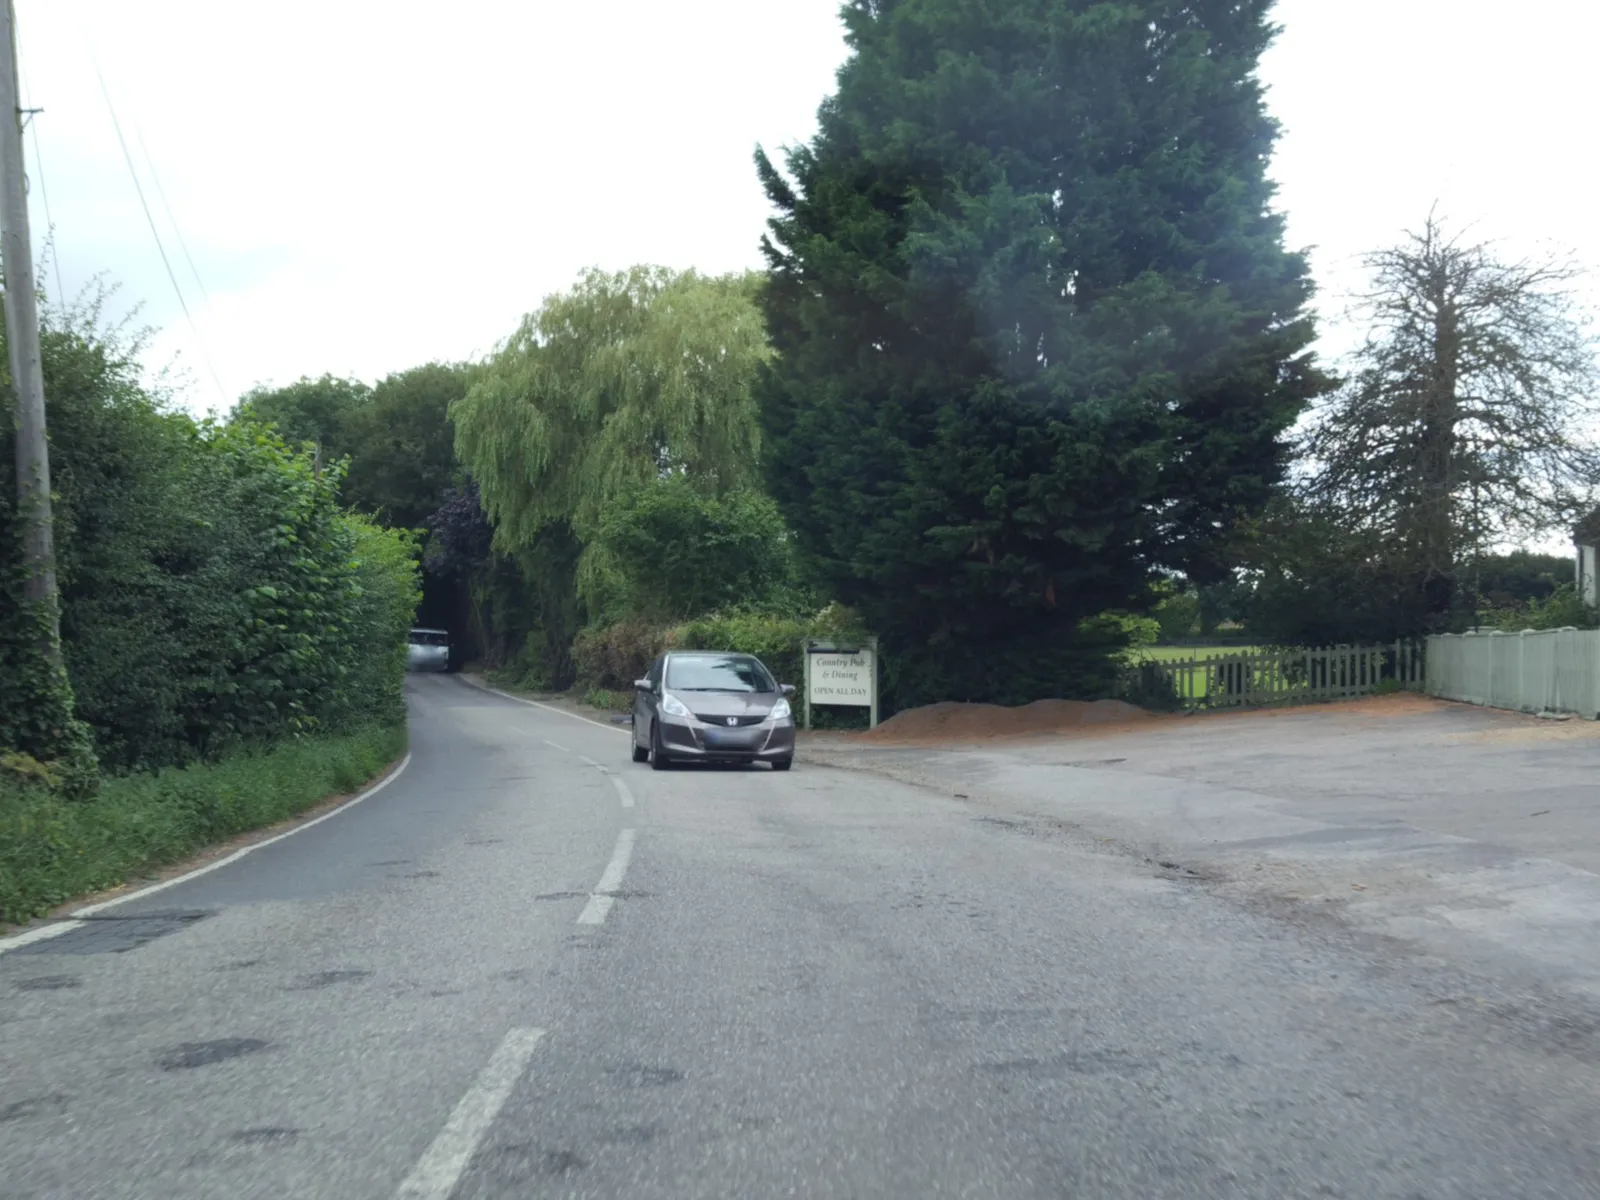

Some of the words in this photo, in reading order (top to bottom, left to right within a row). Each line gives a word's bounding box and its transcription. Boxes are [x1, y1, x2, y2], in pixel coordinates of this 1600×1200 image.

[816, 658, 848, 667] Country
[850, 657, 866, 667] Pub
[831, 670, 859, 681] Dining
[835, 687, 849, 695] ALL
[850, 688, 867, 696] DAY
